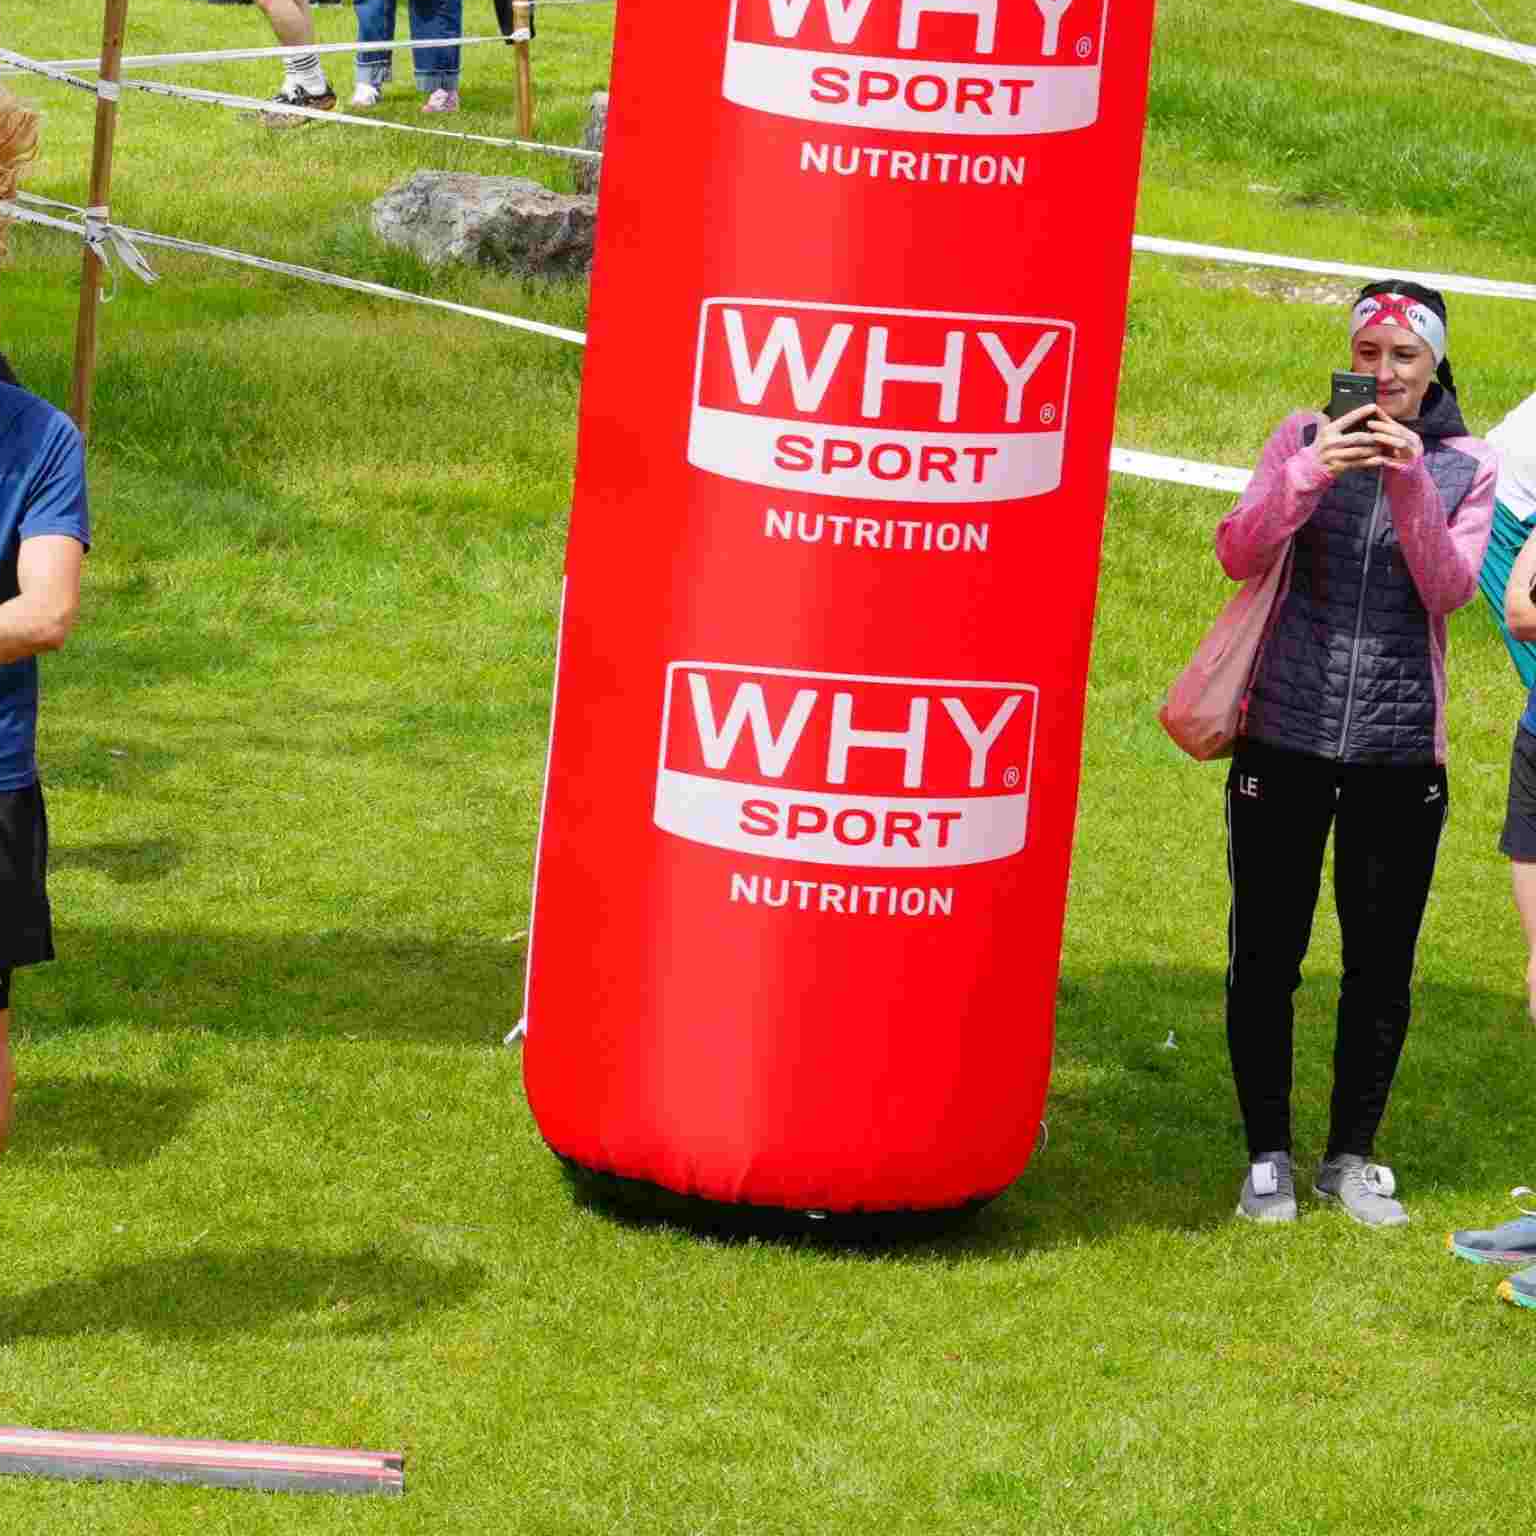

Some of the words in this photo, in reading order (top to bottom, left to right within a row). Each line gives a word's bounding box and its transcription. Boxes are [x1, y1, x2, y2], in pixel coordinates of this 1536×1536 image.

[810, 67, 1034, 116] SPORT
[800, 142, 1025, 184] NUTRITION
[774, 434, 997, 483] SPORT
[764, 508, 988, 552] NUTRITION
[739, 799, 962, 848] SPORT
[730, 873, 953, 915] NUTRITION
